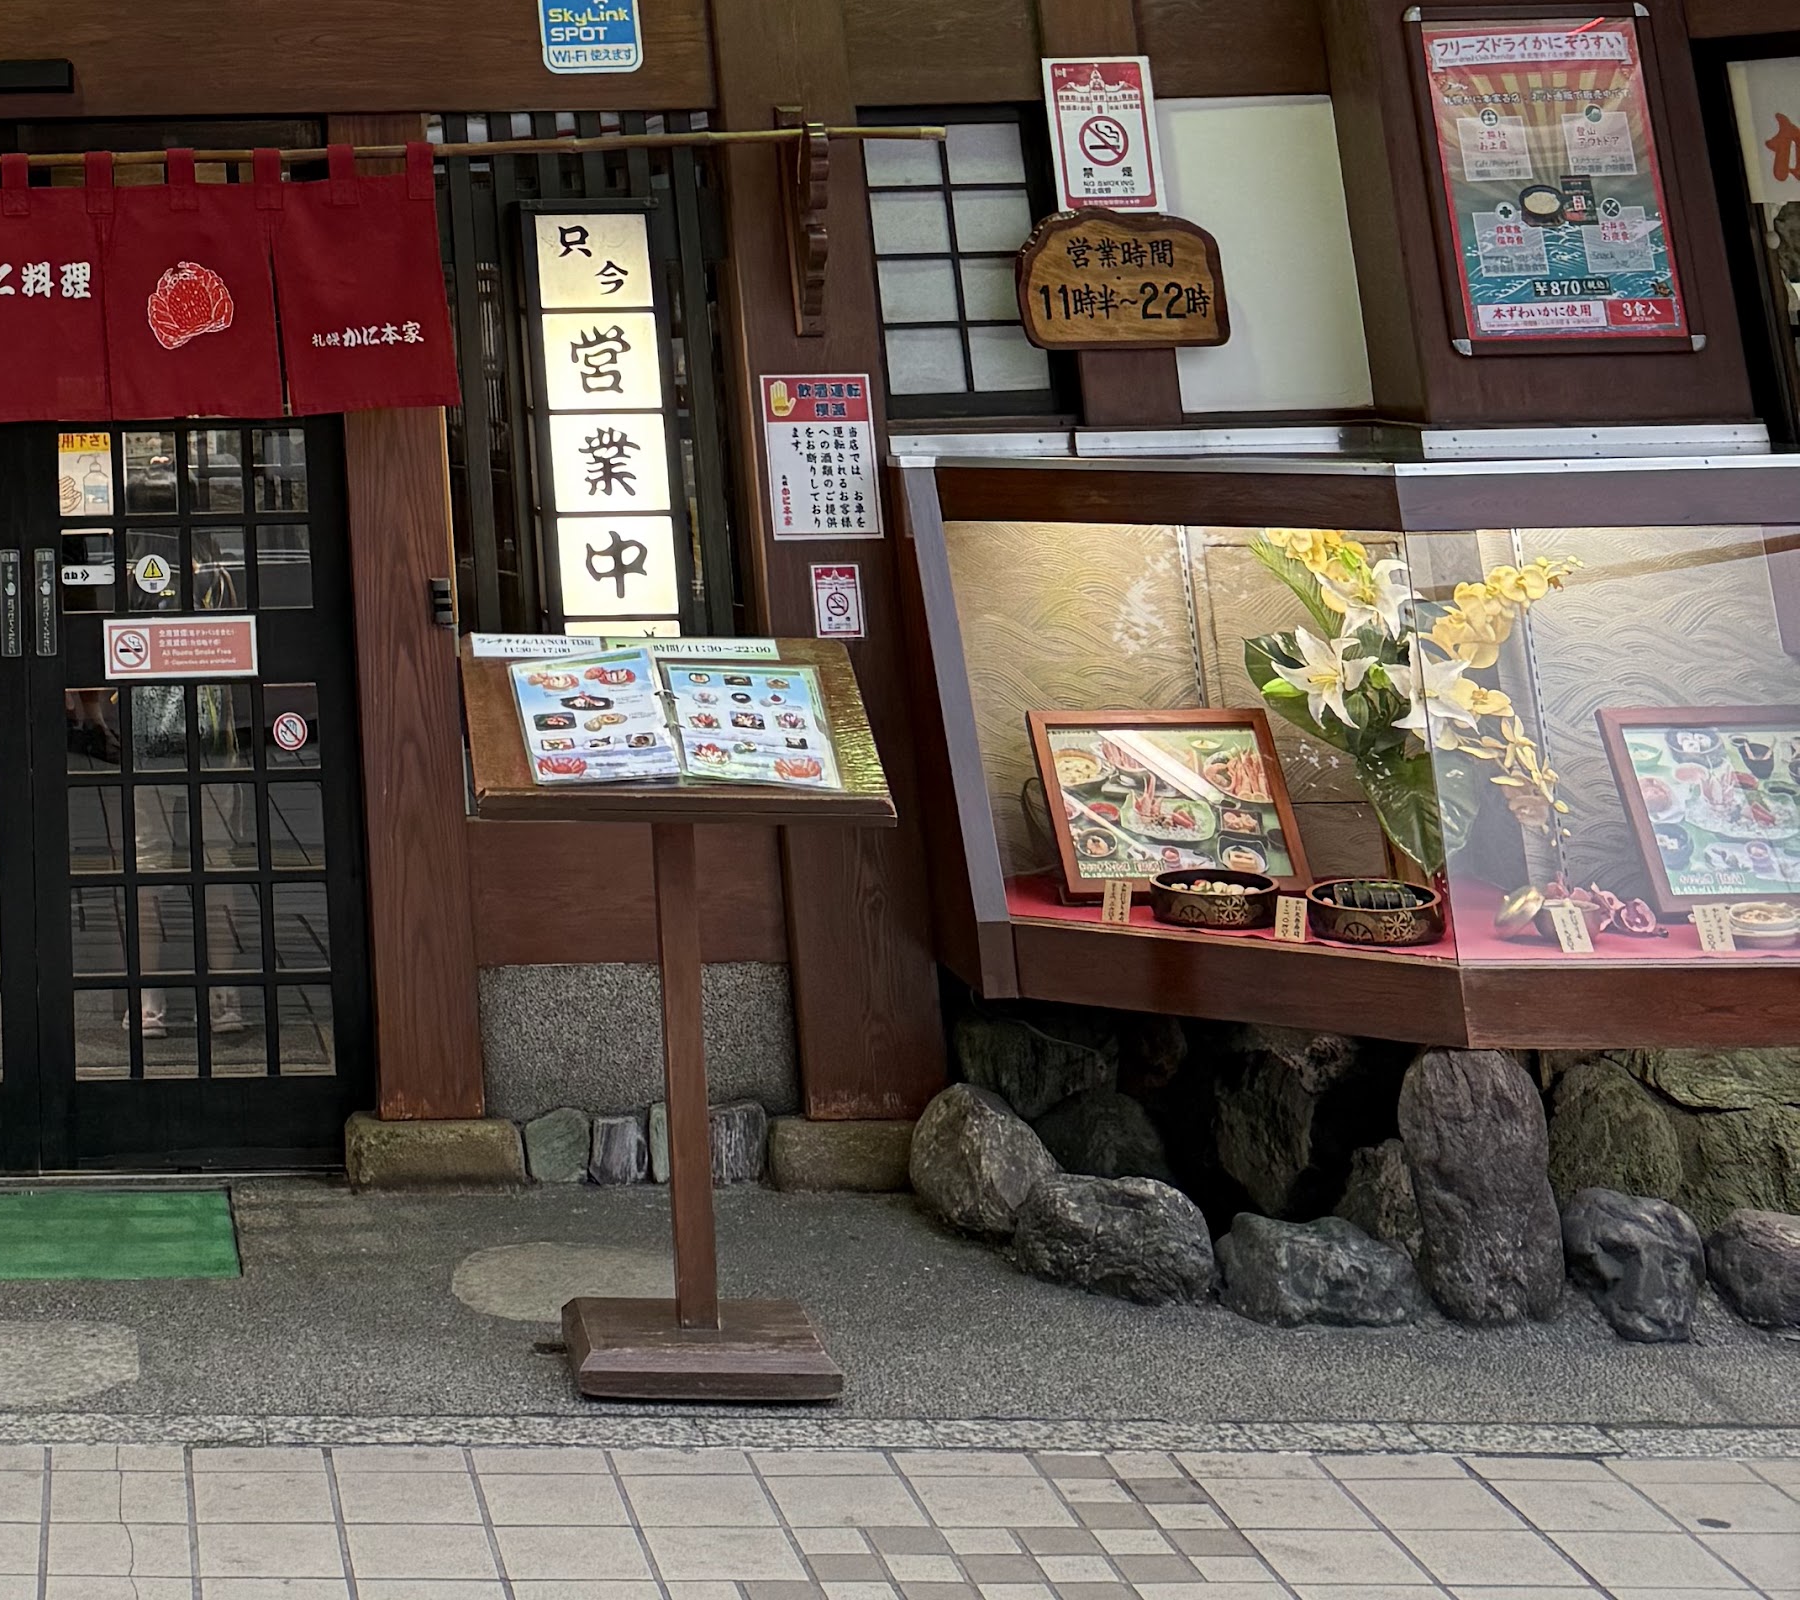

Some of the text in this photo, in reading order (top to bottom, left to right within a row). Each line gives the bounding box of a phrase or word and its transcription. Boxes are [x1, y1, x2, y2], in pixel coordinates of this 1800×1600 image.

[547, 6, 630, 27] SkyLink
[550, 26, 608, 42] SPOT
[1436, 33, 1621, 57] フリーズドライかにぞうすい
[552, 49, 587, 63] Wi-Fi
[558, 225, 628, 295] 只今
[1066, 238, 1174, 269] 営業時間
[1492, 303, 1592, 319] 本ずわいかに使用
[1622, 301, 1662, 317] 3食入
[791, 427, 803, 456] ます。
[570, 324, 648, 600] 営業中
[805, 427, 821, 528] をお断りしており
[833, 426, 853, 528] 運転されるお客様
